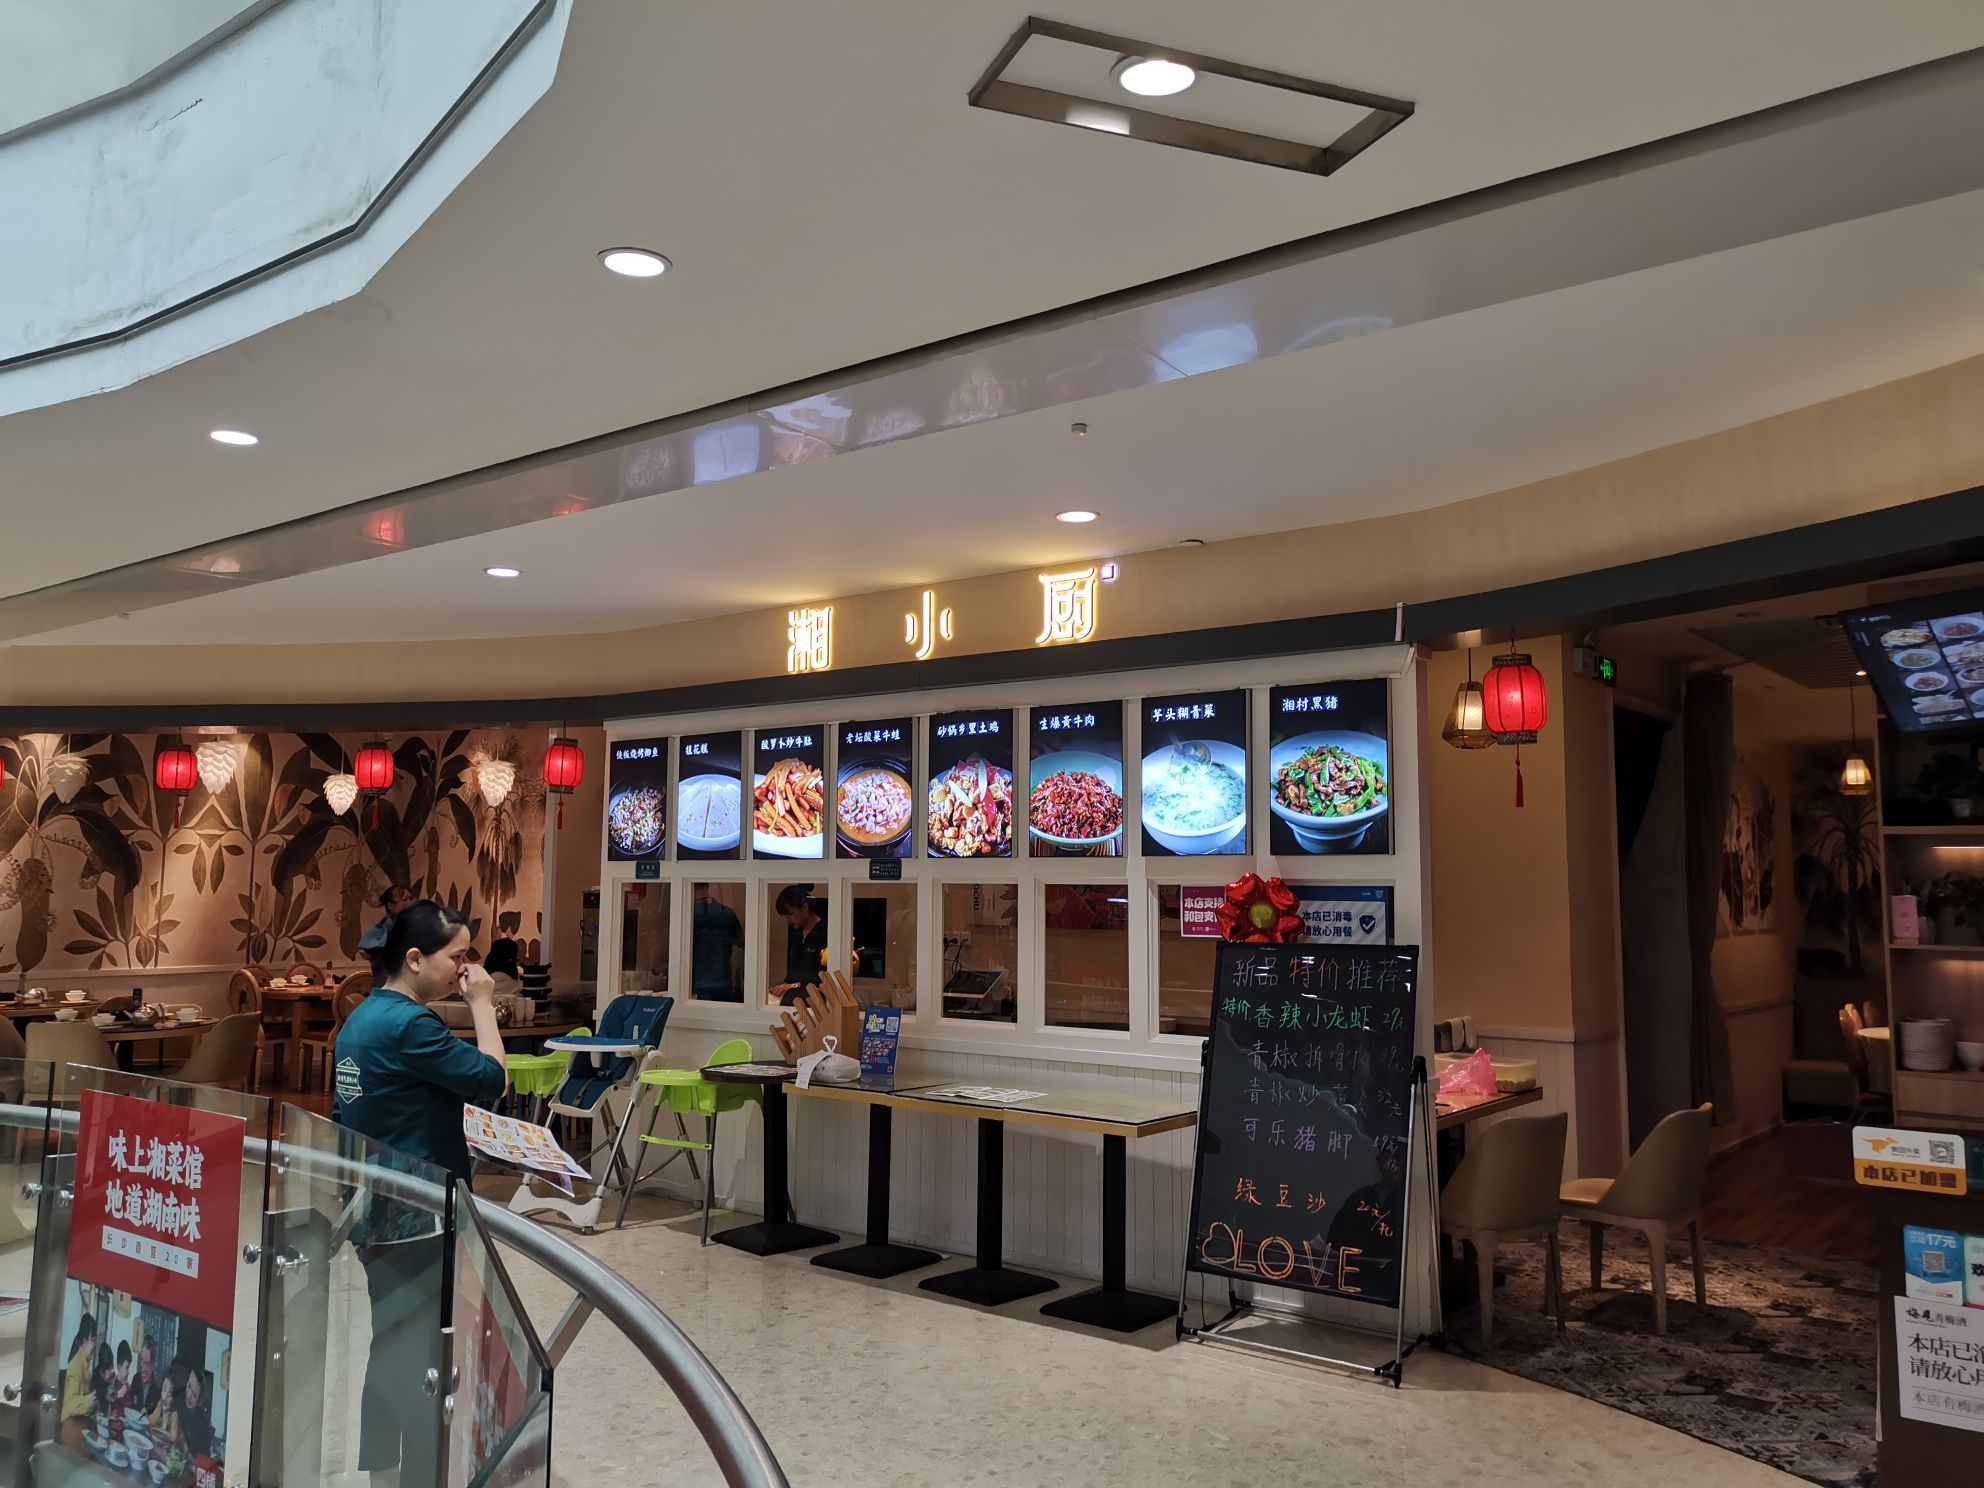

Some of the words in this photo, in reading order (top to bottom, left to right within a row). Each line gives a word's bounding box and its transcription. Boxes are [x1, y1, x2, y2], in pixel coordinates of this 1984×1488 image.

[787, 567, 1098, 673] 湘小厨
[1152, 703, 1216, 722] 芋头糊青菜
[1282, 695, 1338, 713] 湘村黑猪
[936, 720, 1000, 738] 砂锅乡里土鸡
[1039, 713, 1096, 731] 生爆黄牛肉
[760, 735, 813, 751] 酸萝卜炒牛肚
[845, 729, 901, 744] 老坛酸菜牛蛙
[684, 742, 709, 756] 桂花糕
[1302, 910, 1353, 922] 本店已消毒
[1242, 1117, 1353, 1161] 可乐猪脚
[108, 1128, 205, 1191] 味上湘菜馆
[1234, 1176, 1329, 1214] 绿豆沙
[104, 1178, 202, 1244] 地道湖南味
[1233, 1228, 1363, 1293] LOVE
